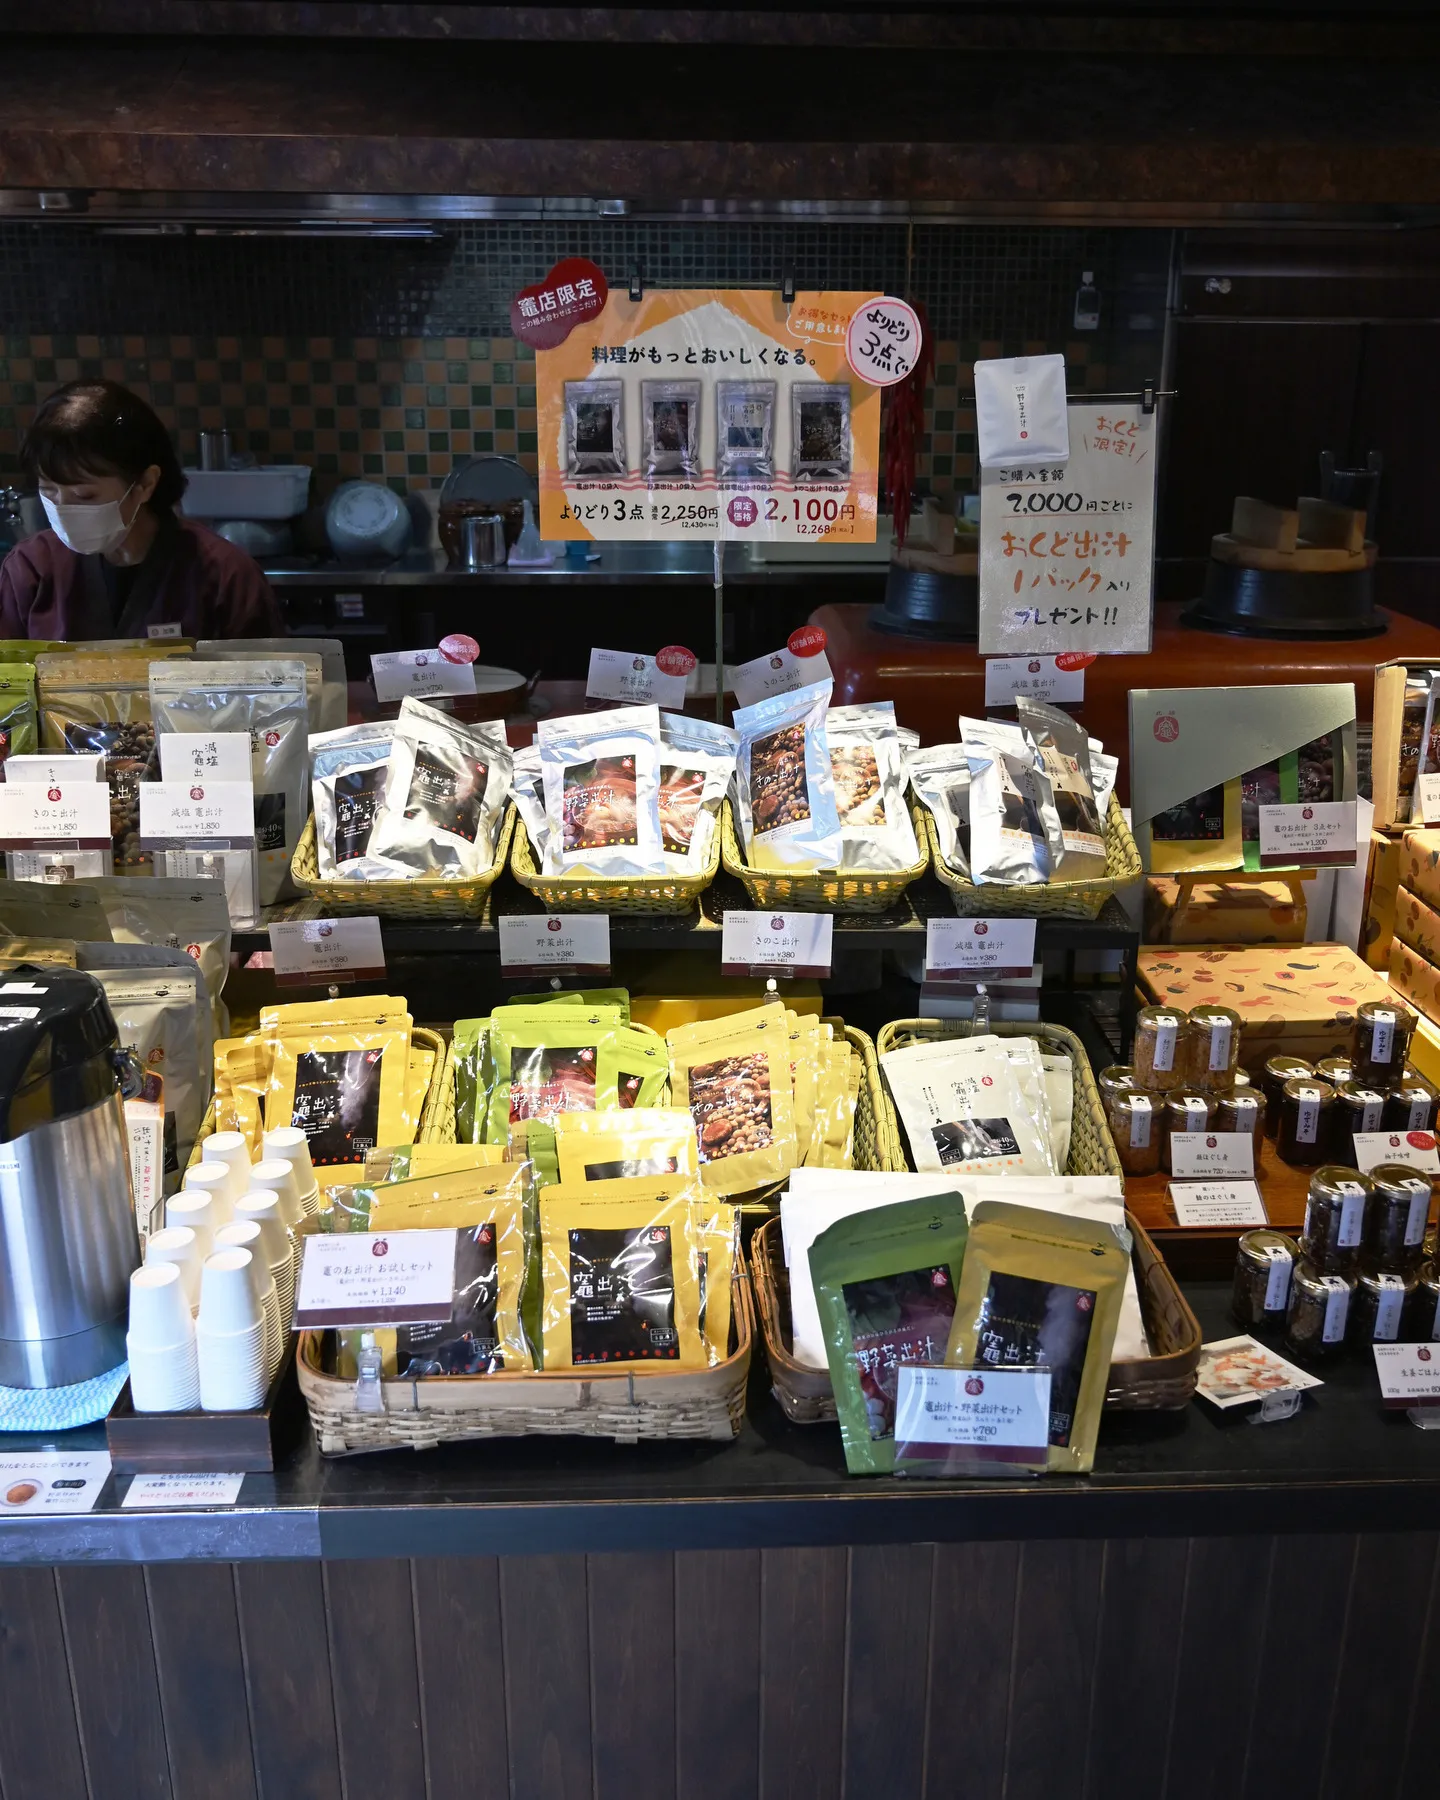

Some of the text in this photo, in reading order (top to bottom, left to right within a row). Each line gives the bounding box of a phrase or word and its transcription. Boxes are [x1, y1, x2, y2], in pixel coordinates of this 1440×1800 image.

[517, 279, 597, 317] 竈店限定
[866, 309, 910, 342] よりどり
[591, 346, 817, 367] 料理がもっとおいしくなる。
[1095, 415, 1141, 438] おくど
[999, 468, 1064, 483] ご購入金額
[559, 499, 645, 521] よりどり3点
[661, 505, 718, 521] 2,250円
[733, 501, 752, 511] 限定
[764, 497, 856, 523] 2,100円
[733, 512, 752, 522] 価格
[1000, 529, 1133, 558] おくど出汁
[536, 938, 575, 947] 野菜出汁
[755, 937, 800, 946] きのこ出汁
[556, 950, 575, 958] ¥380
[776, 951, 796, 959] ¥380
[371, 1285, 406, 1296] ¥1,140
[857, 1335, 934, 1374] 野菜出汁
[982, 1329, 1046, 1365] 竈出汁
